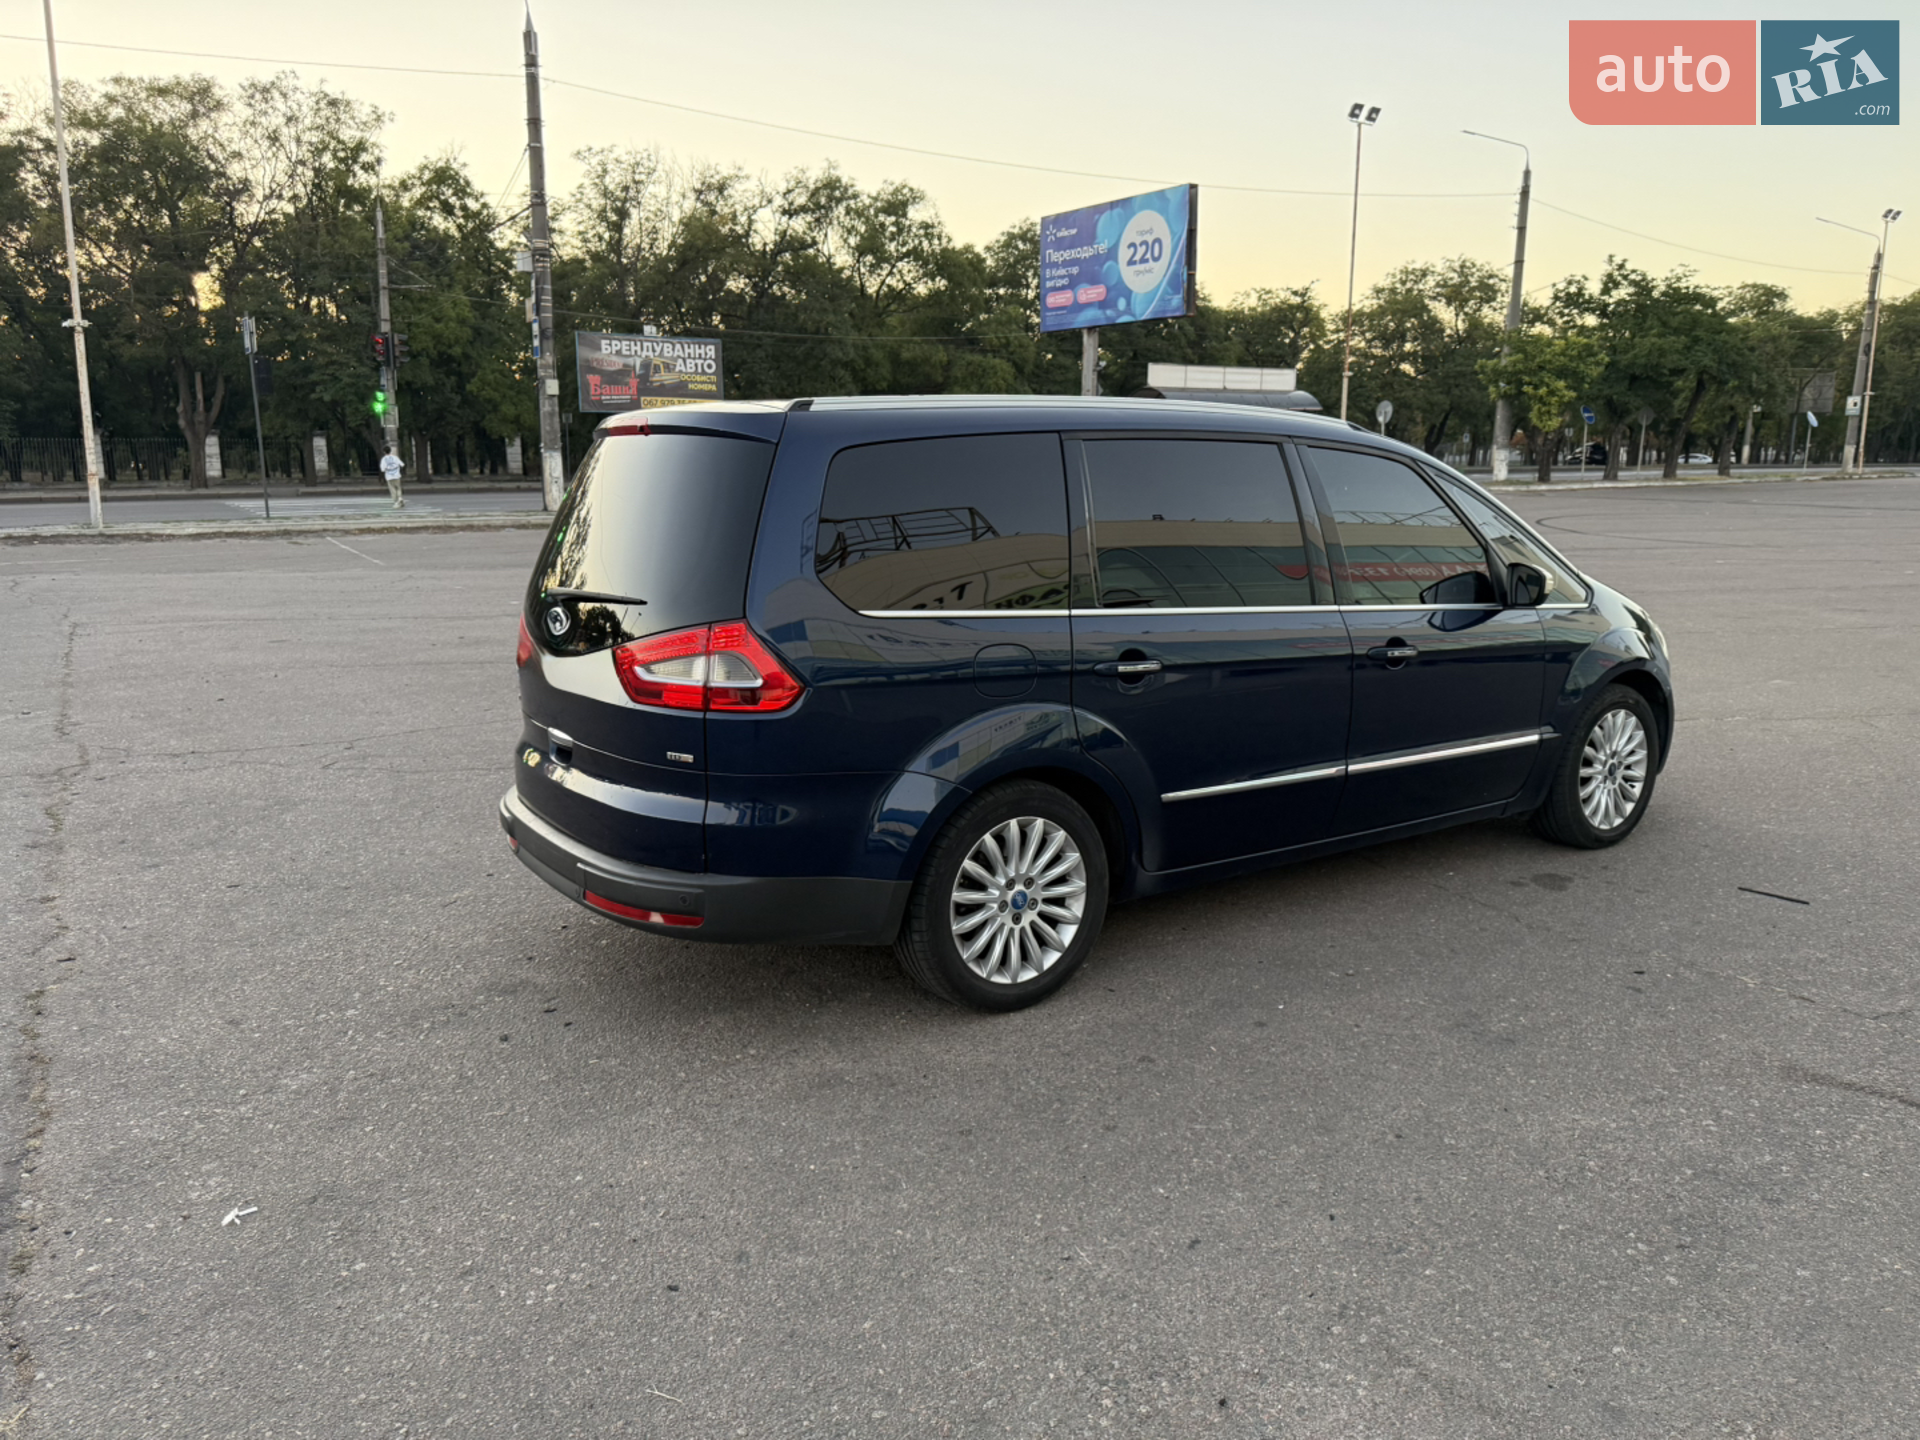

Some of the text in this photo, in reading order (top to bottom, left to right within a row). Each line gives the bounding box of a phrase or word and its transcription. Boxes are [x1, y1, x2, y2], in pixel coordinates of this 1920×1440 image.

[1045, 239, 1108, 264] Переходьте!
[1126, 236, 1163, 267] 220
[600, 339, 716, 359] БРЕНДУВАННЯ
[675, 359, 717, 374] АВТО
[688, 383, 717, 392] НОМЕРА
